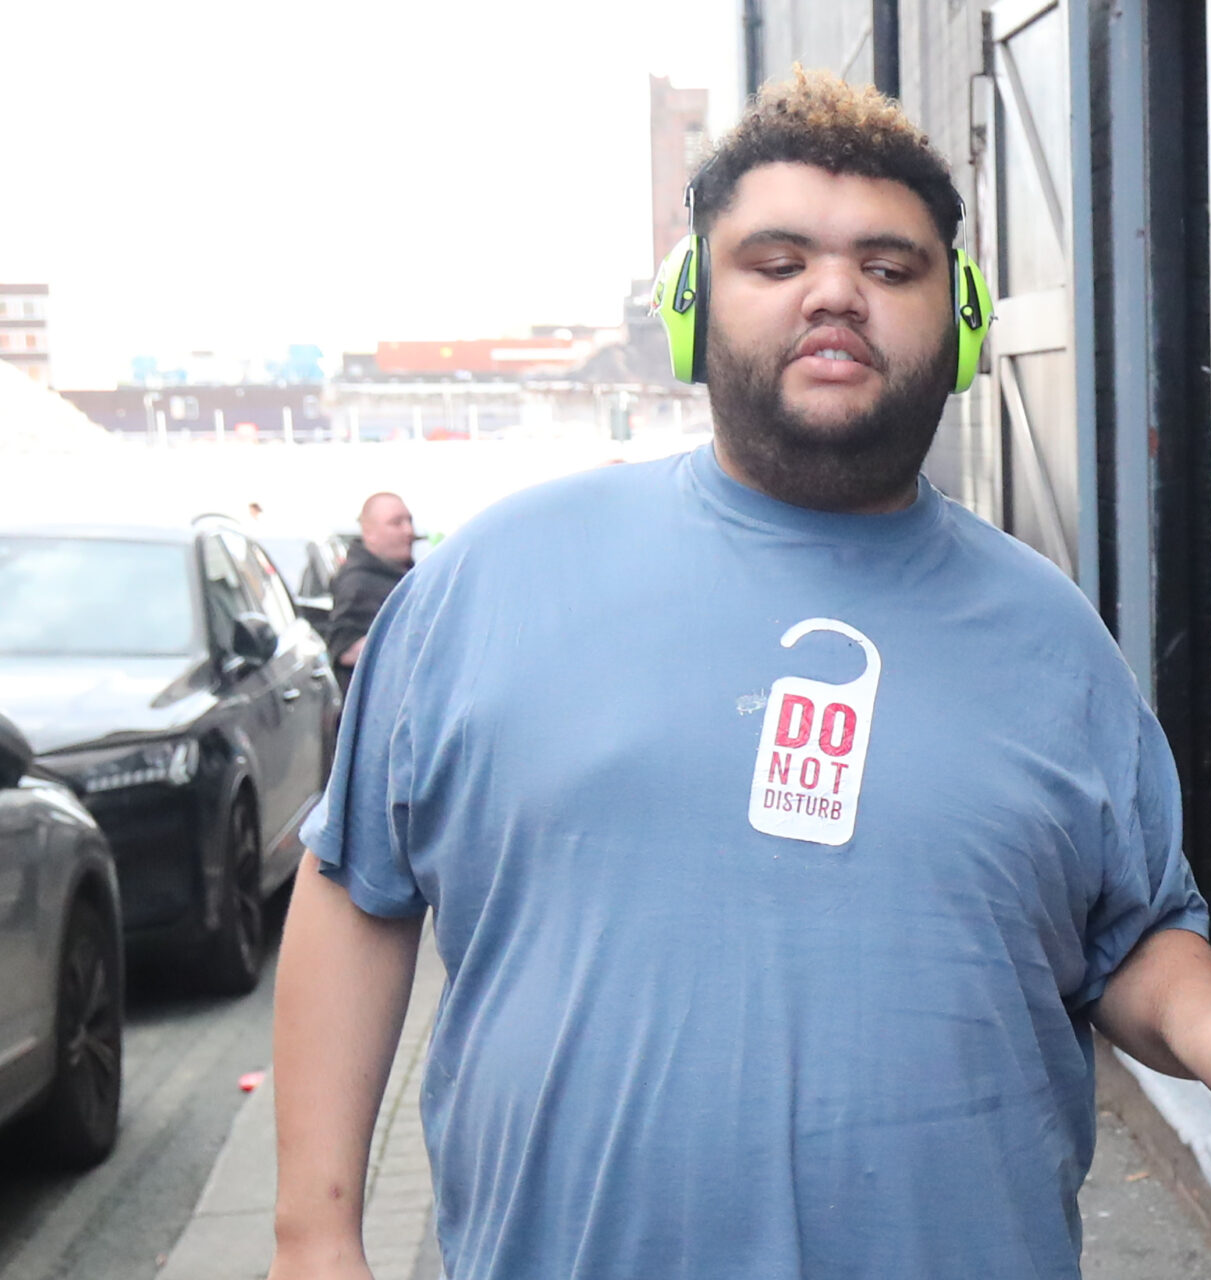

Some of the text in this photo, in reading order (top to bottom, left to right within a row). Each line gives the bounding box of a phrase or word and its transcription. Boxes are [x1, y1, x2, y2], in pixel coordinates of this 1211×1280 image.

[774, 693, 857, 758] DO
[768, 751, 849, 794] NOT
[763, 788, 843, 820] DISTURB
